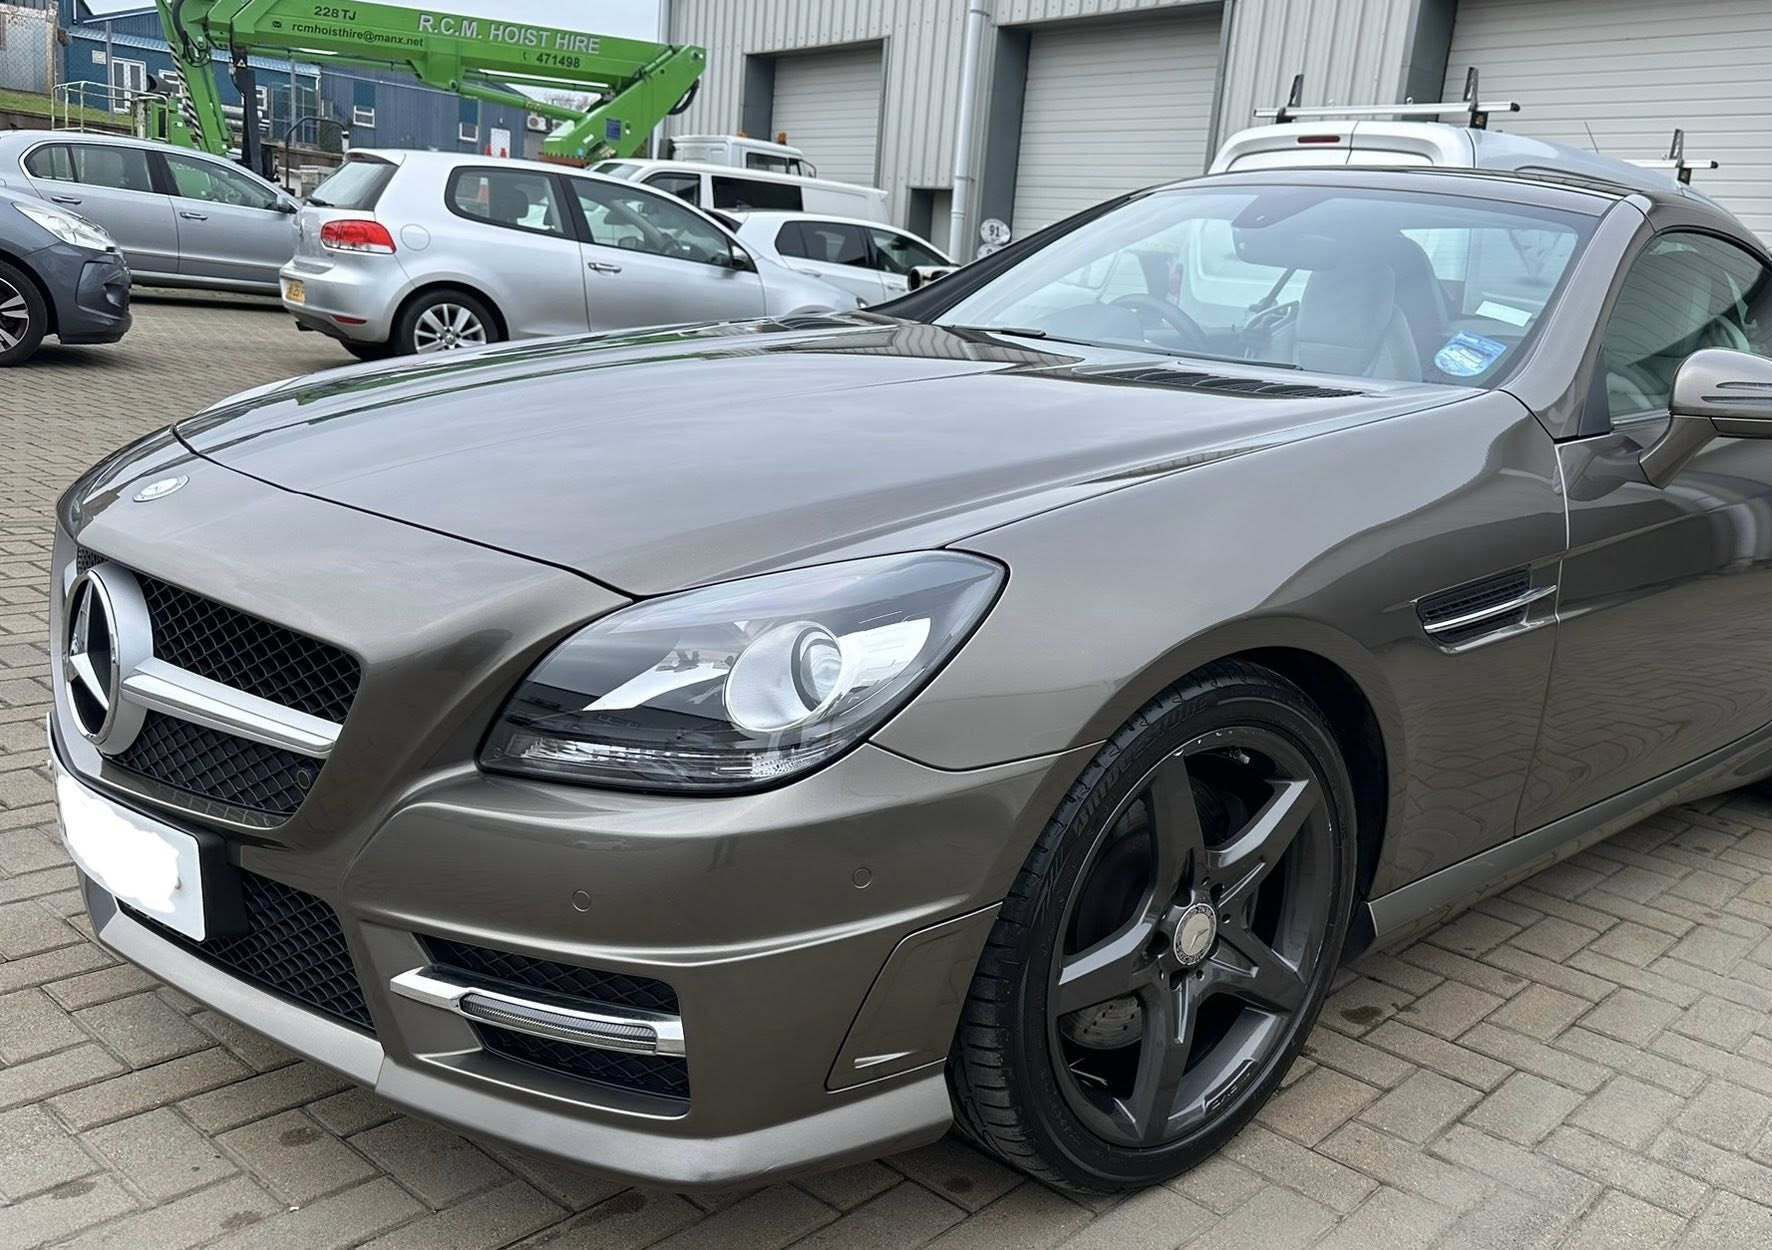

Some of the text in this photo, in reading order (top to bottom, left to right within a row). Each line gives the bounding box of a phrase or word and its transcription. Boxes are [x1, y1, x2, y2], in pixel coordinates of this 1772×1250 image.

[291, 22, 424, 47] rcmhoisthire@manx.net
[418, 14, 601, 55] R.C.M. HOIST HIRE
[536, 52, 581, 69] 471498
[988, 224, 1000, 238] 91
